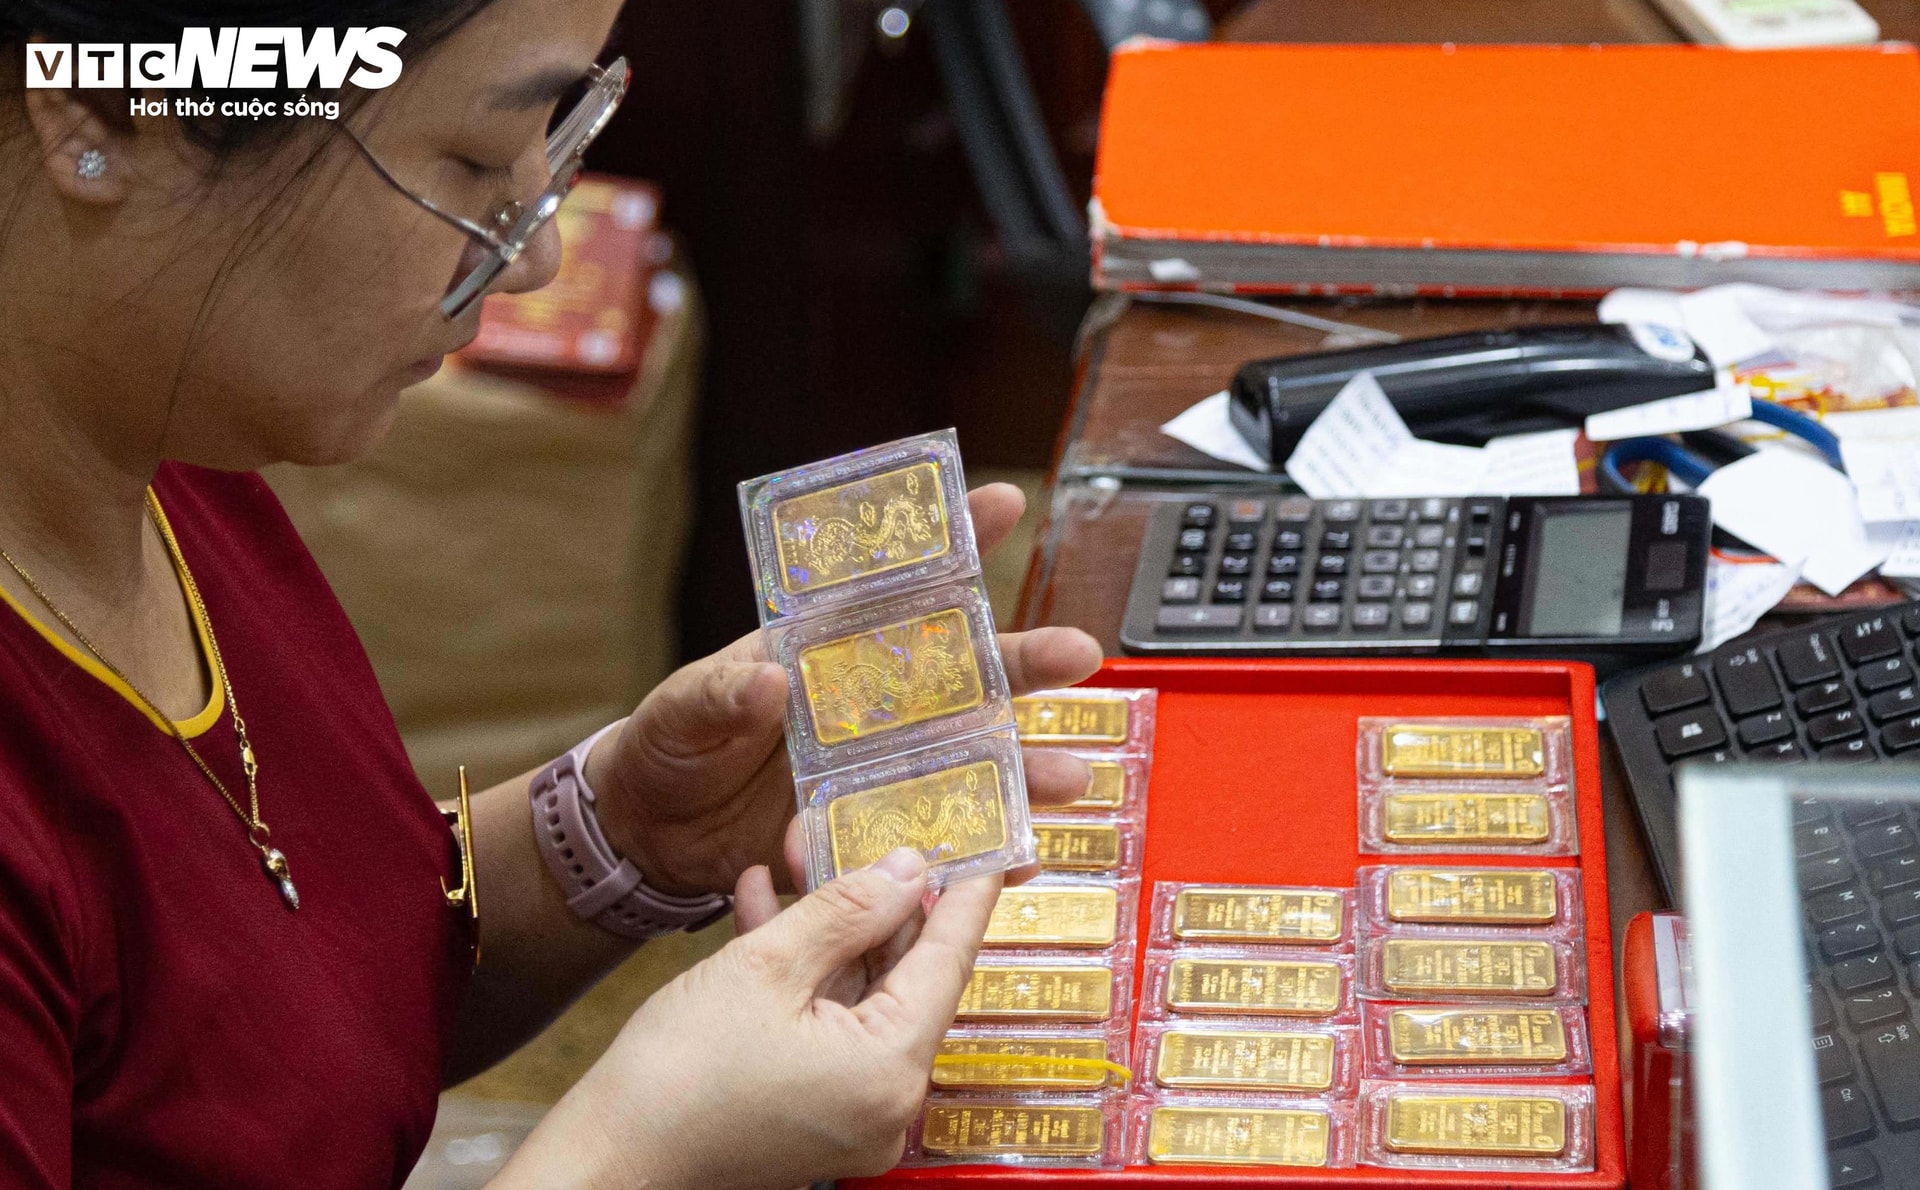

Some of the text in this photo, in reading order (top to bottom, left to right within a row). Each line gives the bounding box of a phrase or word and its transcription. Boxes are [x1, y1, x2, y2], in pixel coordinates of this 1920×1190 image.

[1837, 711, 1851, 721] S
[1849, 740, 1863, 750] D
[1887, 825, 1902, 835] H
[1839, 891, 1854, 900] M
[1841, 1088, 1854, 1102] Ctrl
